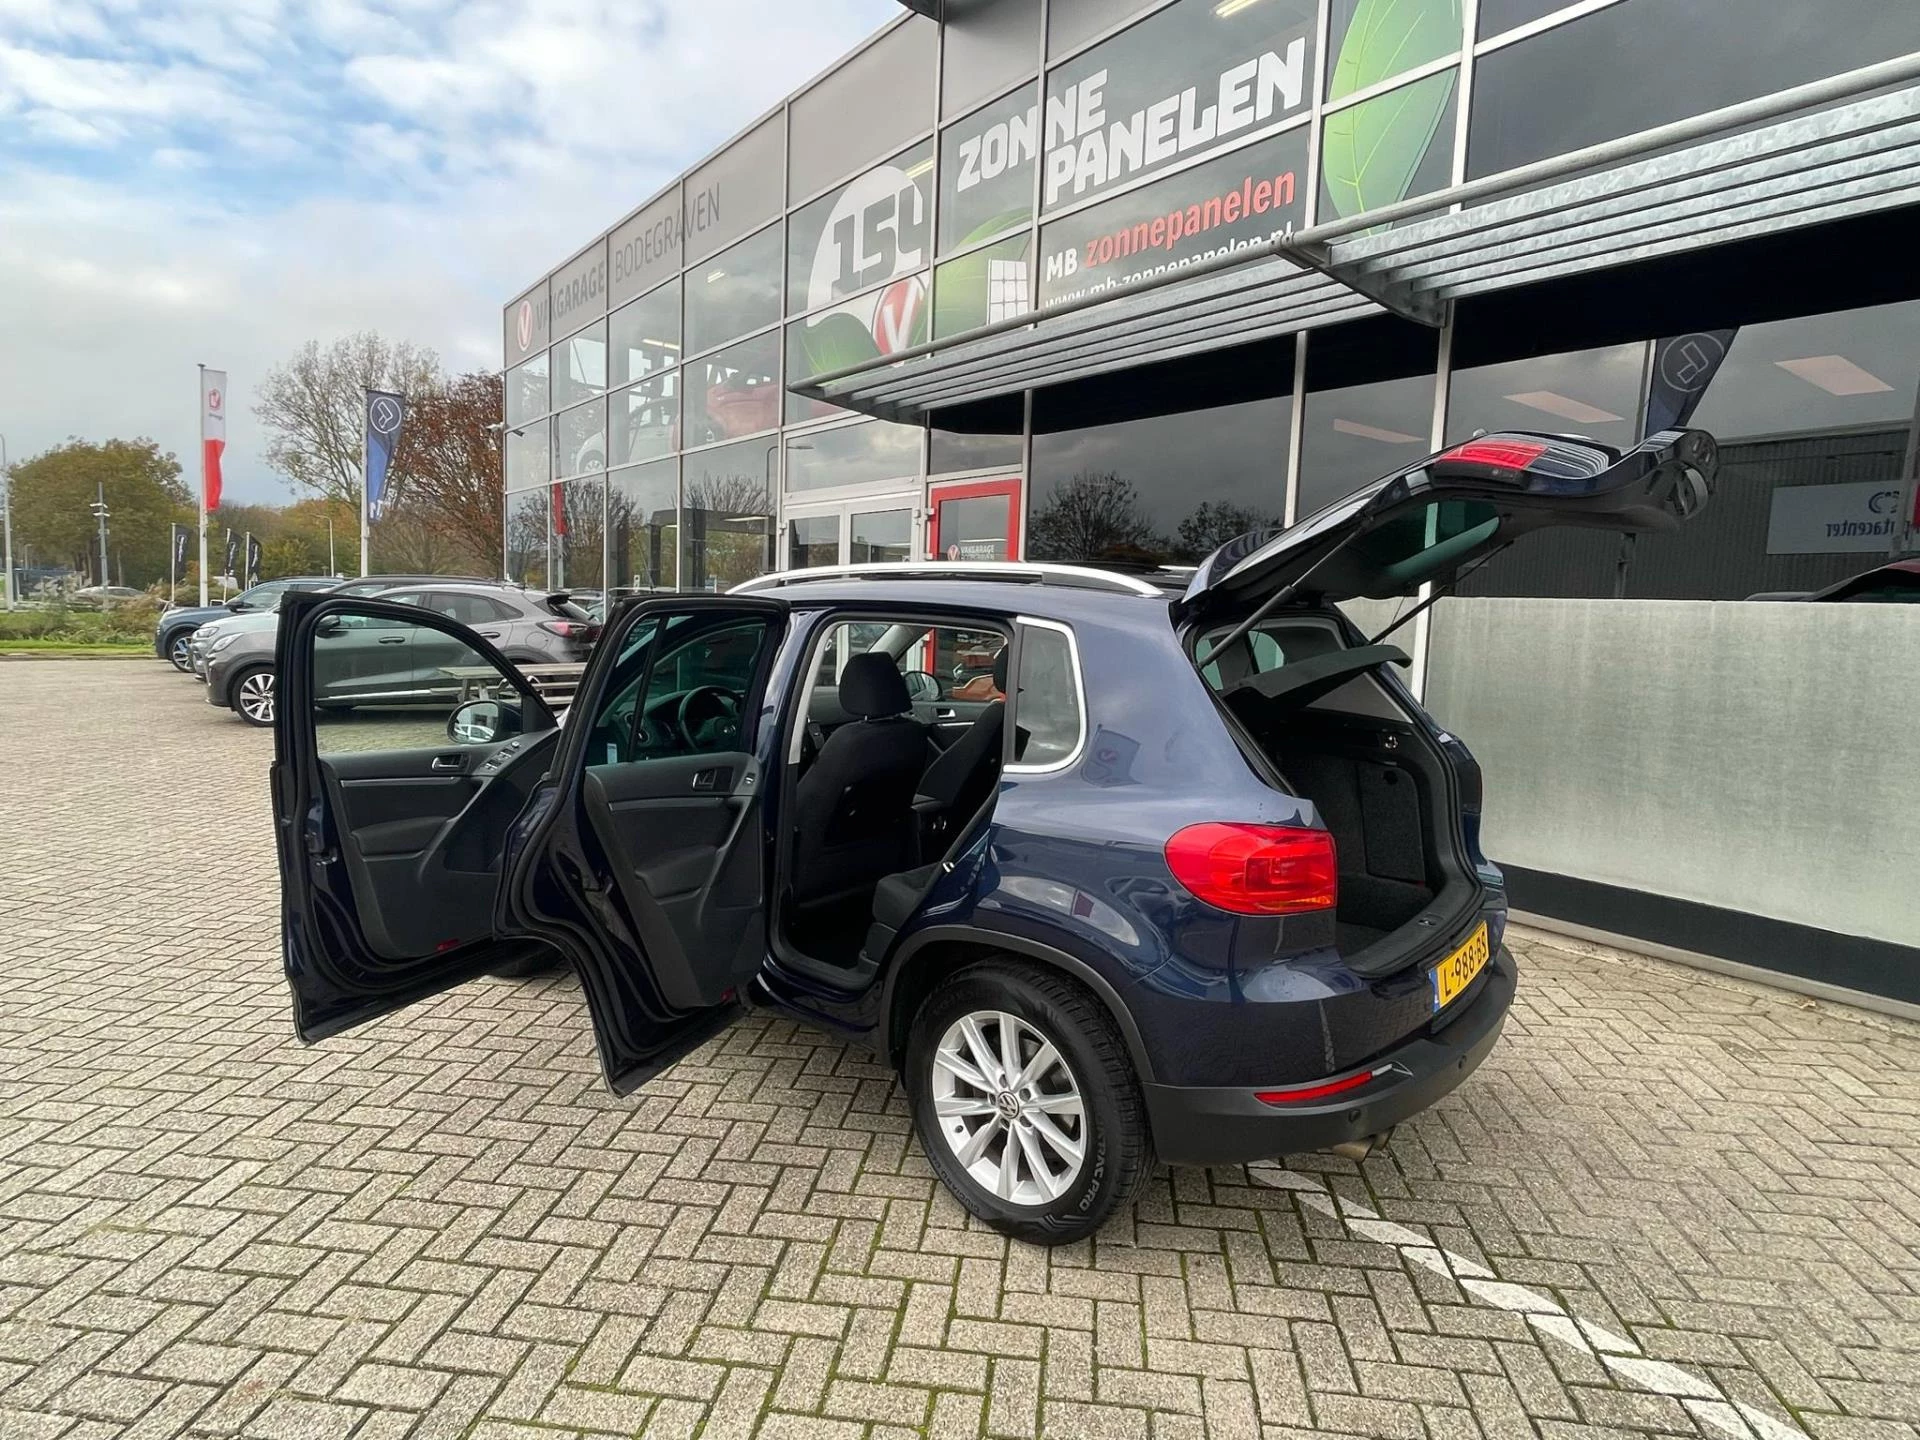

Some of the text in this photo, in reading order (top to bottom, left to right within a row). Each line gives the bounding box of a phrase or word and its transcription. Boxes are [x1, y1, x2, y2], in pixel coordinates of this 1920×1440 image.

[957, 70, 1107, 192] ZONNE
[1046, 37, 1305, 204] PANELEN
[615, 182, 720, 283] BODEGRAVEN
[1045, 221, 1294, 308] wwwmb-zonnepanelennl
[1046, 171, 1294, 282] MB zonnepanelen
[1079, 1179, 1101, 1212] PRO
